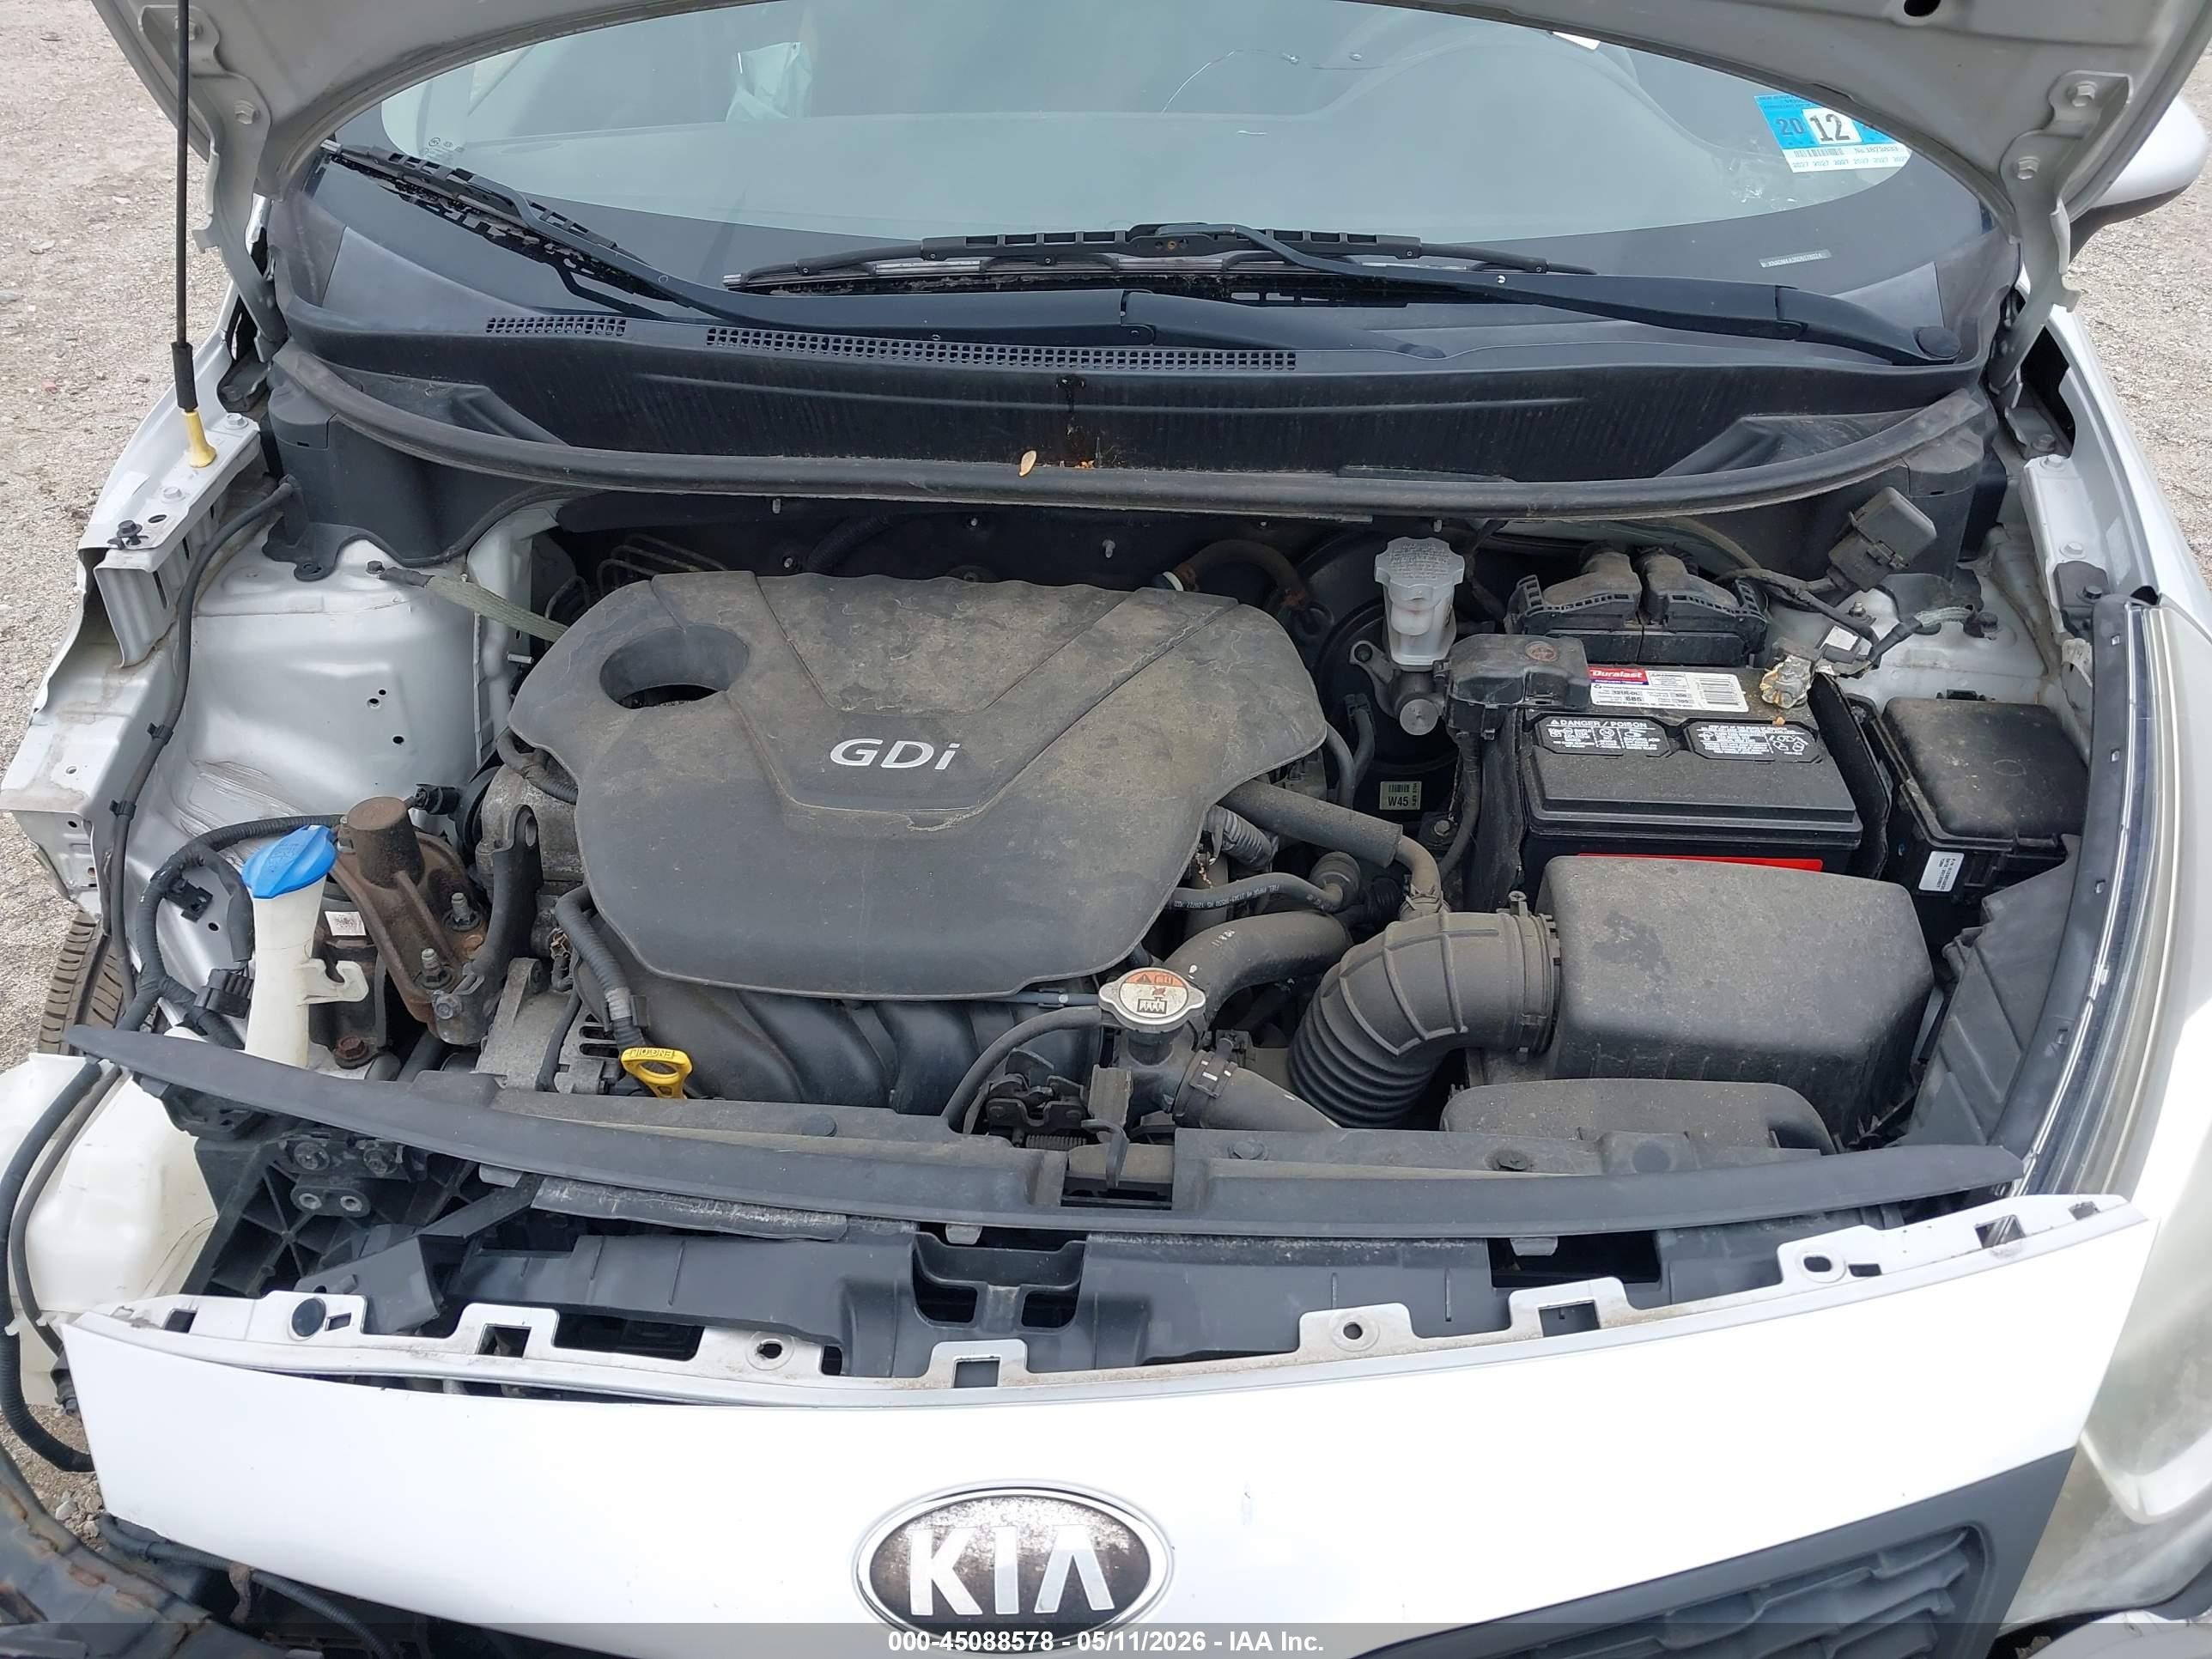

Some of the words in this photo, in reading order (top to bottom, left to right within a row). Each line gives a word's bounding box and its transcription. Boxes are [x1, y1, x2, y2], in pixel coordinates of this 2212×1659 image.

[1776, 118, 1803, 136] 20
[1809, 113, 1850, 142] 12
[1592, 669, 1643, 678] Duralast
[830, 738, 961, 770] GDi
[1388, 796, 1408, 807] W45
[907, 1524, 1115, 1616] KIA
